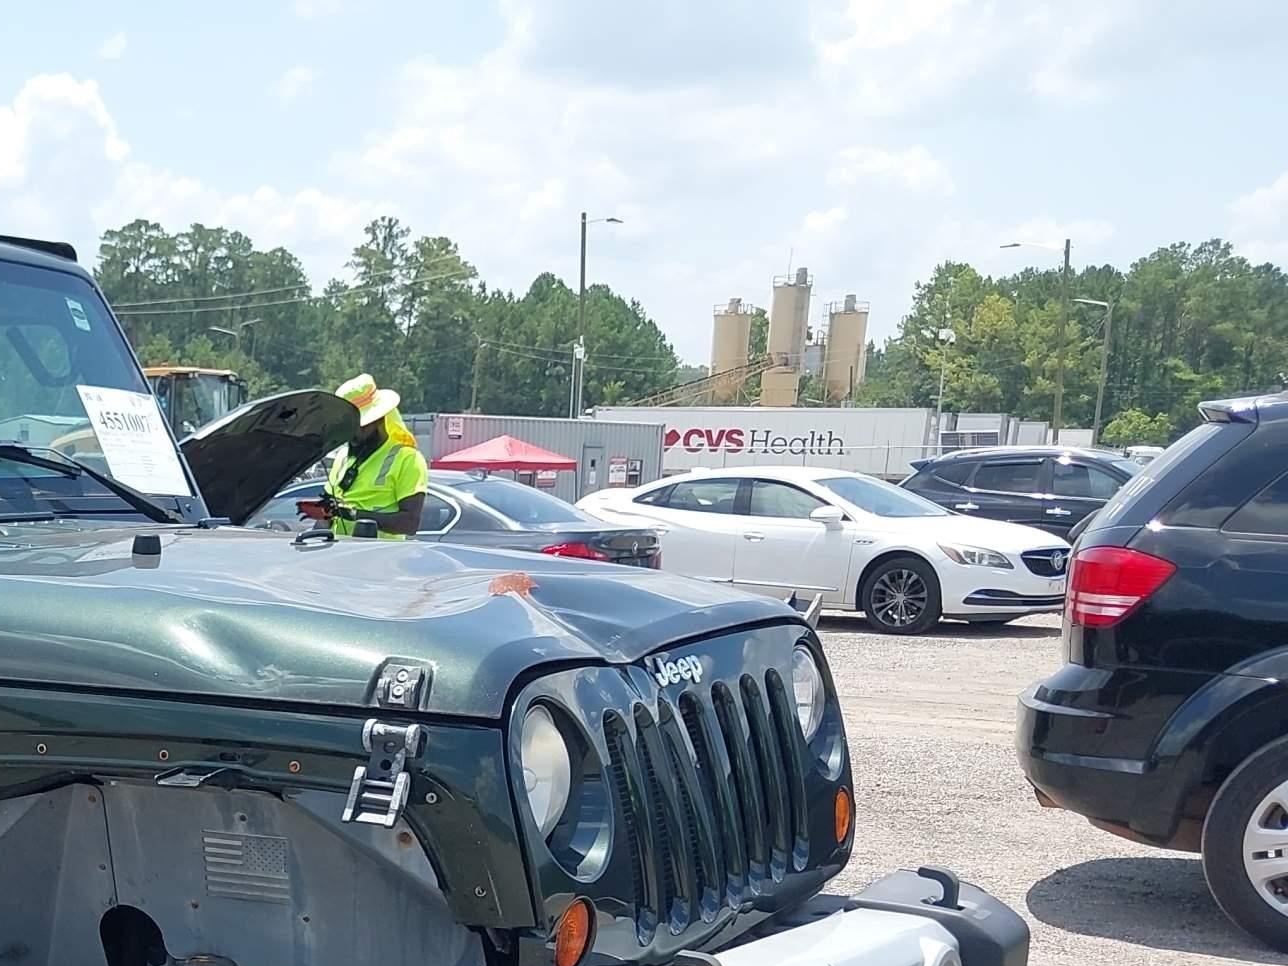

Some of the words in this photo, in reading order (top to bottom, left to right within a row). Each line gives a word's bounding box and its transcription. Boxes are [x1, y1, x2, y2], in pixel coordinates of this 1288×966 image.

[682, 429, 744, 454] CVS
[747, 430, 845, 456] Health
[655, 655, 703, 688] Jeep
